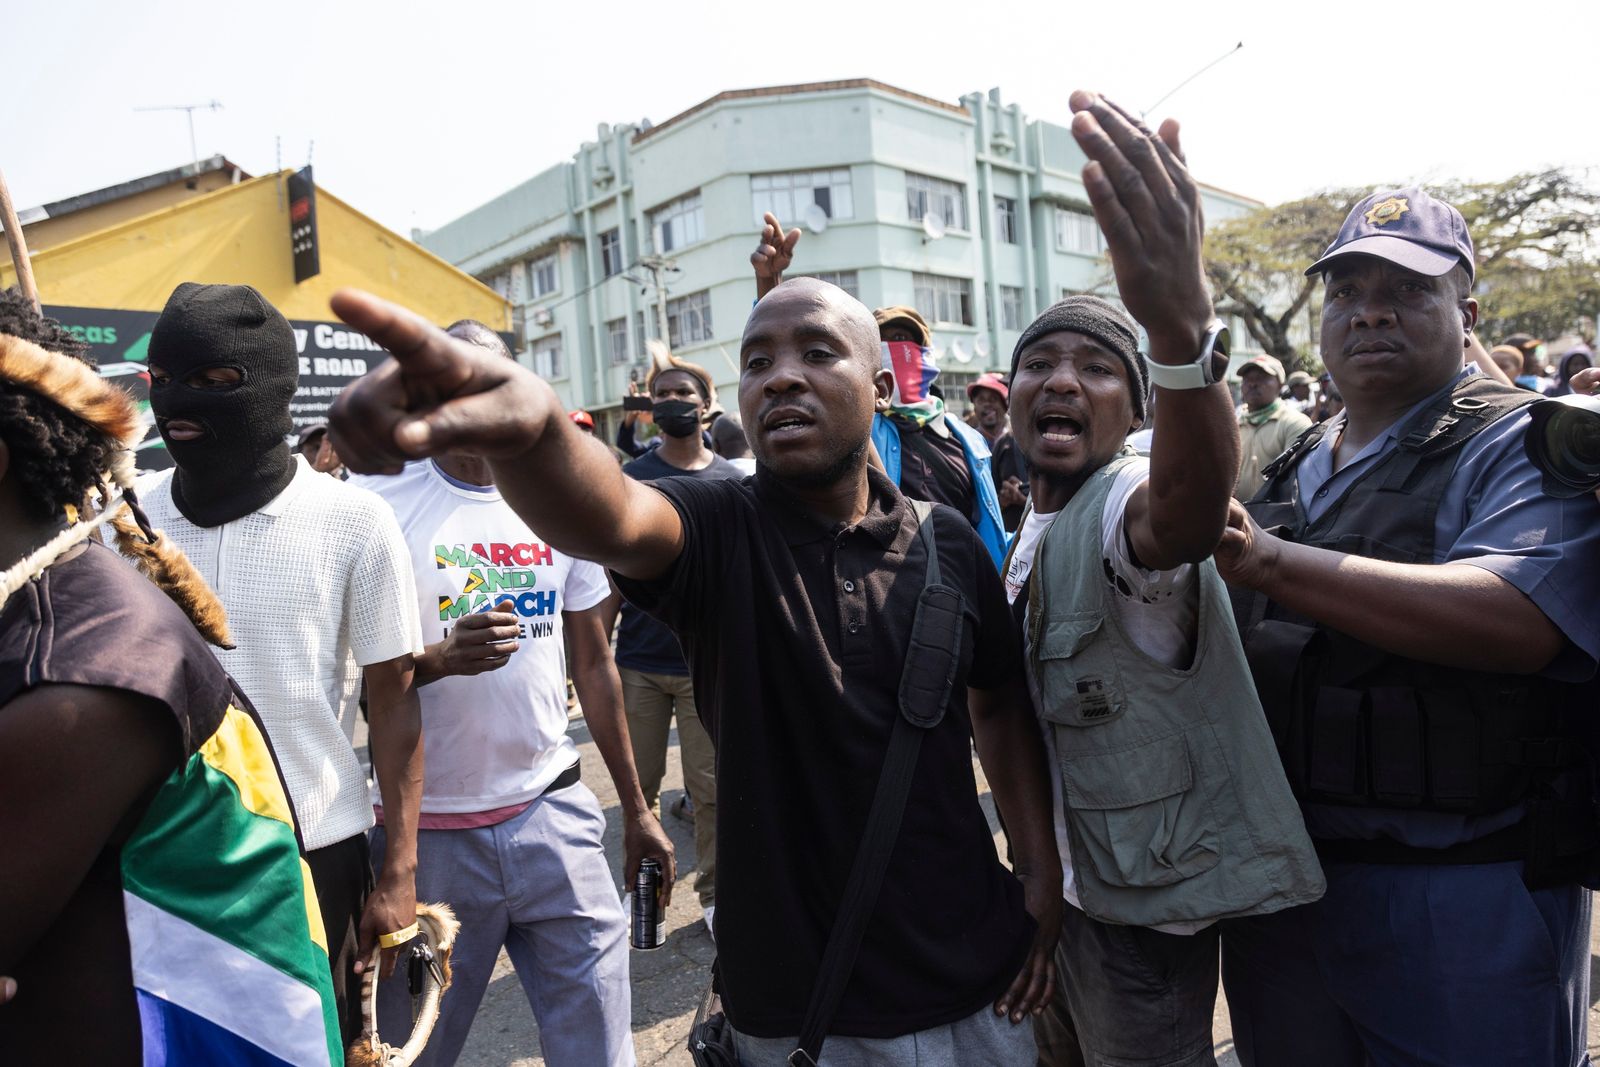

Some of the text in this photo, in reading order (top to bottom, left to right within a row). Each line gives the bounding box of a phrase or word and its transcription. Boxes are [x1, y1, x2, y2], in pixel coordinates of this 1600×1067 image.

[313, 357, 368, 377] ROAD
[435, 542, 554, 569] MARCH
[462, 568, 536, 593] AND
[438, 590, 556, 622] MARCH
[531, 621, 554, 639] WIN
